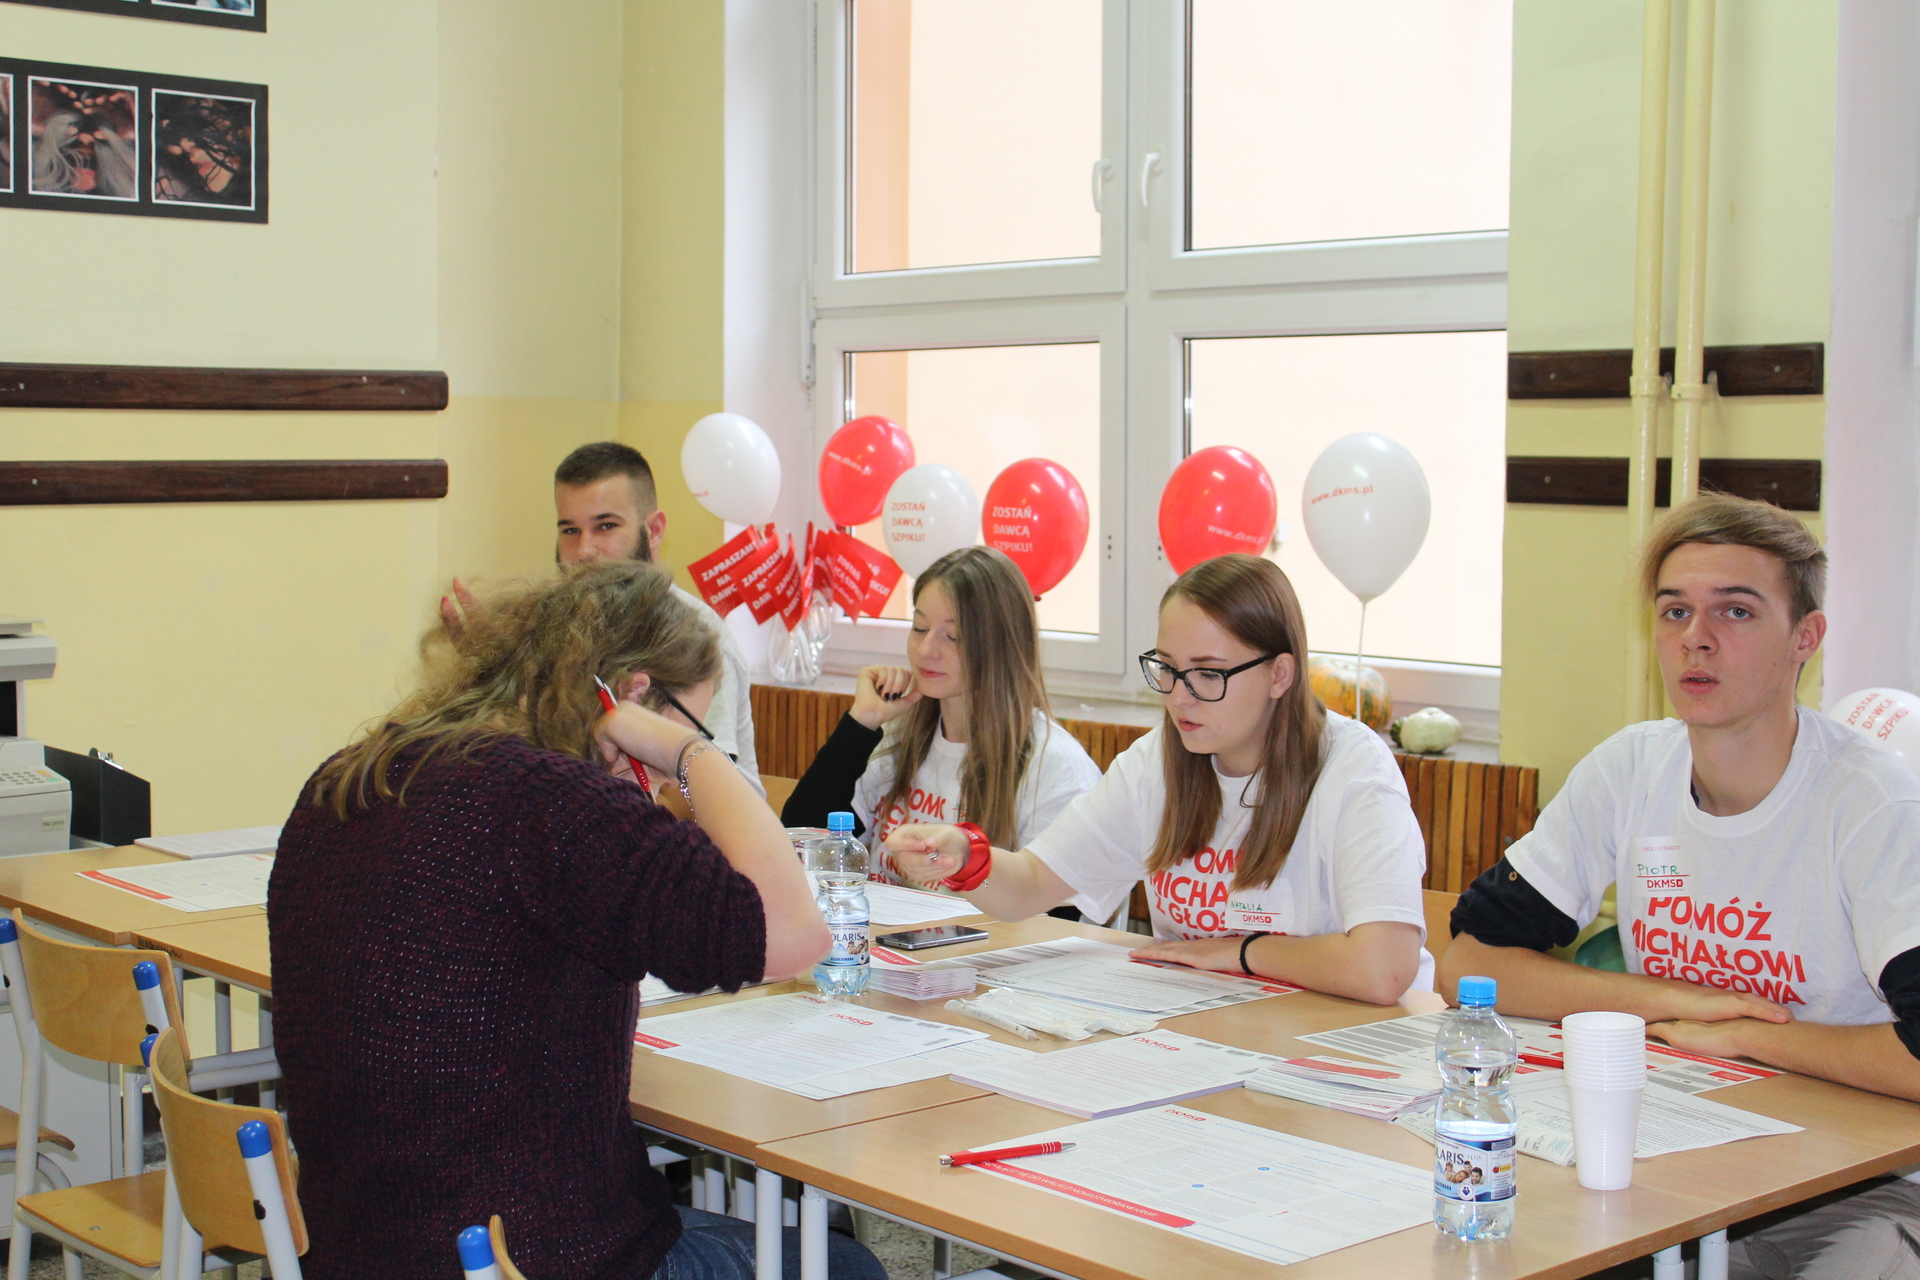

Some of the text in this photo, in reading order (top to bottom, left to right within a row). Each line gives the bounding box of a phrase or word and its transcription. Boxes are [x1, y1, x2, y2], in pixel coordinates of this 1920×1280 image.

[1311, 484, 1374, 505] www.dkms.pl
[891, 500, 926, 511] ZOSTAŃ
[992, 505, 1032, 519] ZOSTAŃ
[892, 517, 923, 528] DAWCĄ
[892, 532, 925, 542] SZPIKU!
[993, 524, 1030, 538] DAWCĄ
[993, 540, 1033, 552] SZPIKU!
[716, 573, 732, 587] NA
[709, 583, 739, 605] DAWC
[1637, 864, 1680, 876] PIOTR
[1150, 869, 1230, 908] MICHA
[1646, 878, 1677, 889] DKMS
[1230, 900, 1264, 913] NATALIA
[1242, 914, 1265, 924] DKMS
[1648, 895, 1773, 942] POMÓŻ
[1643, 955, 1807, 1006] GŁOGOWA
[1434, 1146, 1464, 1166] LARIS
